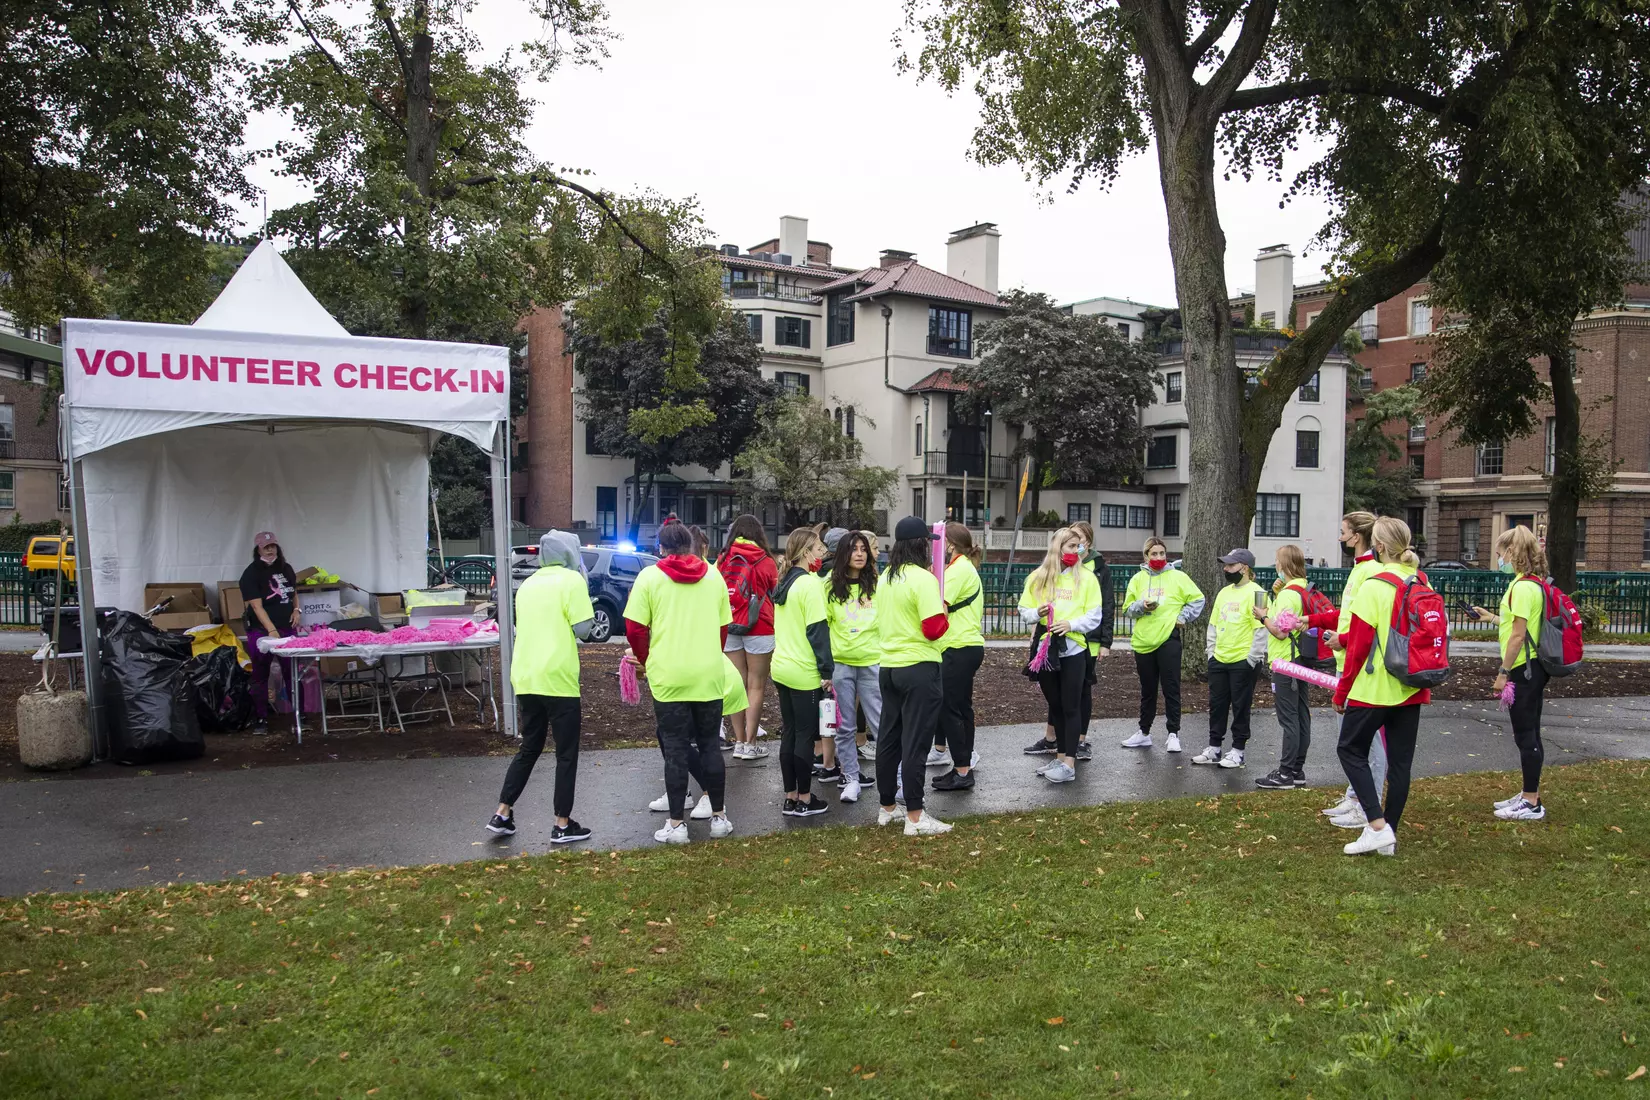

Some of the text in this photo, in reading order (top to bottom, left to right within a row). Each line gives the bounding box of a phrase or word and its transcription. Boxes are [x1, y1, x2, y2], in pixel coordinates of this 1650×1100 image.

[75, 347, 505, 394] VOLUNTEER CHECK-IN
[304, 603, 325, 611] PORT
[1433, 636, 1442, 647] 15
[1275, 660, 1339, 688] MAKING STR
